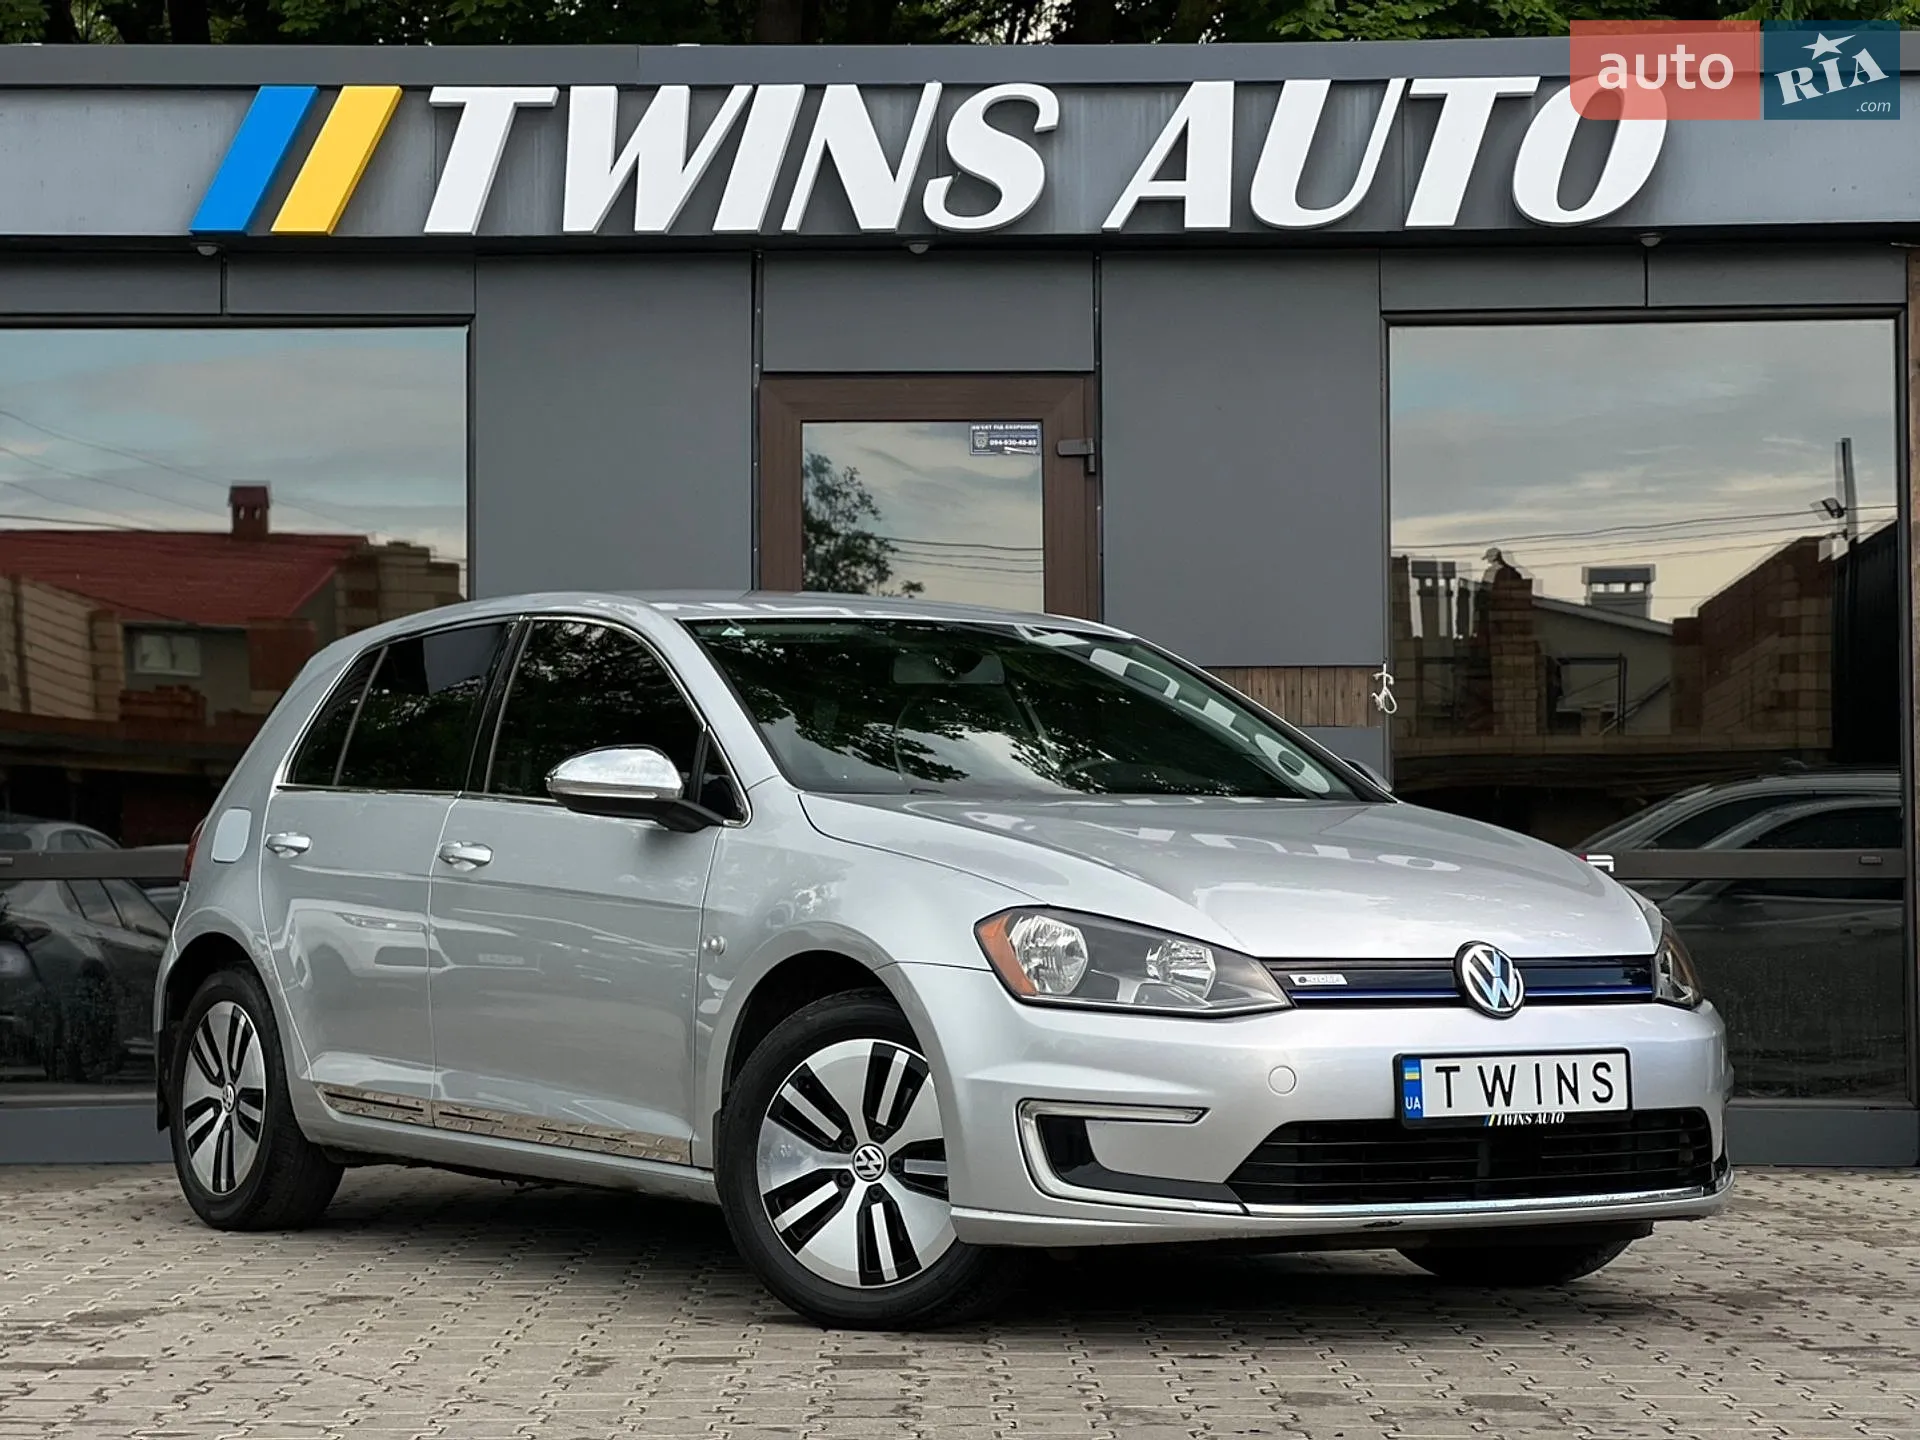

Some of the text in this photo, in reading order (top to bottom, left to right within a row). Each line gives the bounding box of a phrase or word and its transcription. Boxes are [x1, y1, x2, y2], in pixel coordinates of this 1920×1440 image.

[423, 74, 1669, 234] TWINS AUTO
[1405, 1061, 1613, 1110] UA TWINS
[1497, 1112, 1565, 1126] TWINS AUTO
